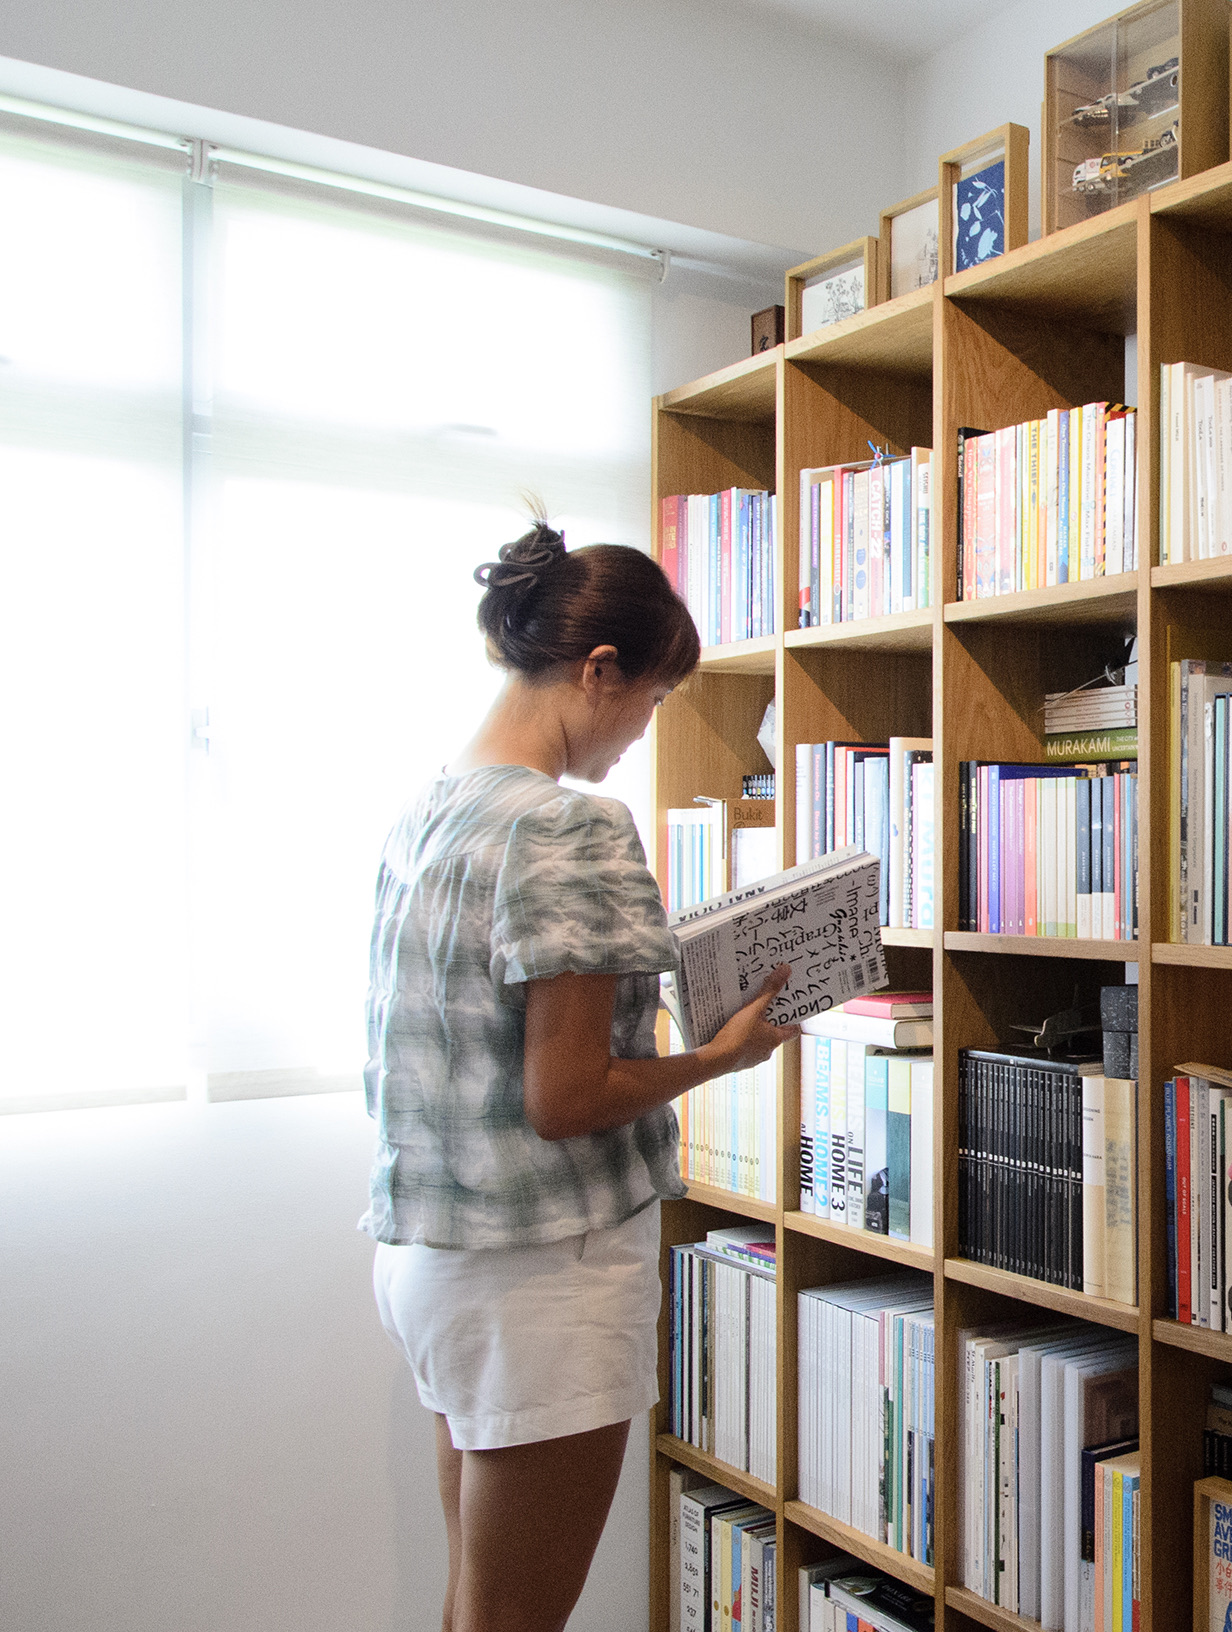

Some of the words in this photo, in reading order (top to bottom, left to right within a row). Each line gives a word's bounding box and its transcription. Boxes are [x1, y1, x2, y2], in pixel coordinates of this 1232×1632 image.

[966, 449, 974, 467] How
[966, 471, 974, 484] We
[1084, 463, 1092, 501] Machine
[870, 479, 882, 559] CATCH-22
[965, 487, 974, 540] Disappeared
[1046, 737, 1111, 756] MURAKAMI
[733, 807, 763, 821] Bukit
[769, 922, 838, 957] Graphic
[815, 1045, 830, 1117] BEAMS
[847, 1131, 854, 1144] ON
[801, 1136, 813, 1197] HOME
[815, 1130, 828, 1190] HOME
[831, 1134, 845, 1195] HOME
[847, 1146, 863, 1195] LIFE
[815, 1191, 827, 1206] 2
[831, 1197, 845, 1209] 3
[751, 1567, 759, 1609] MUJI
